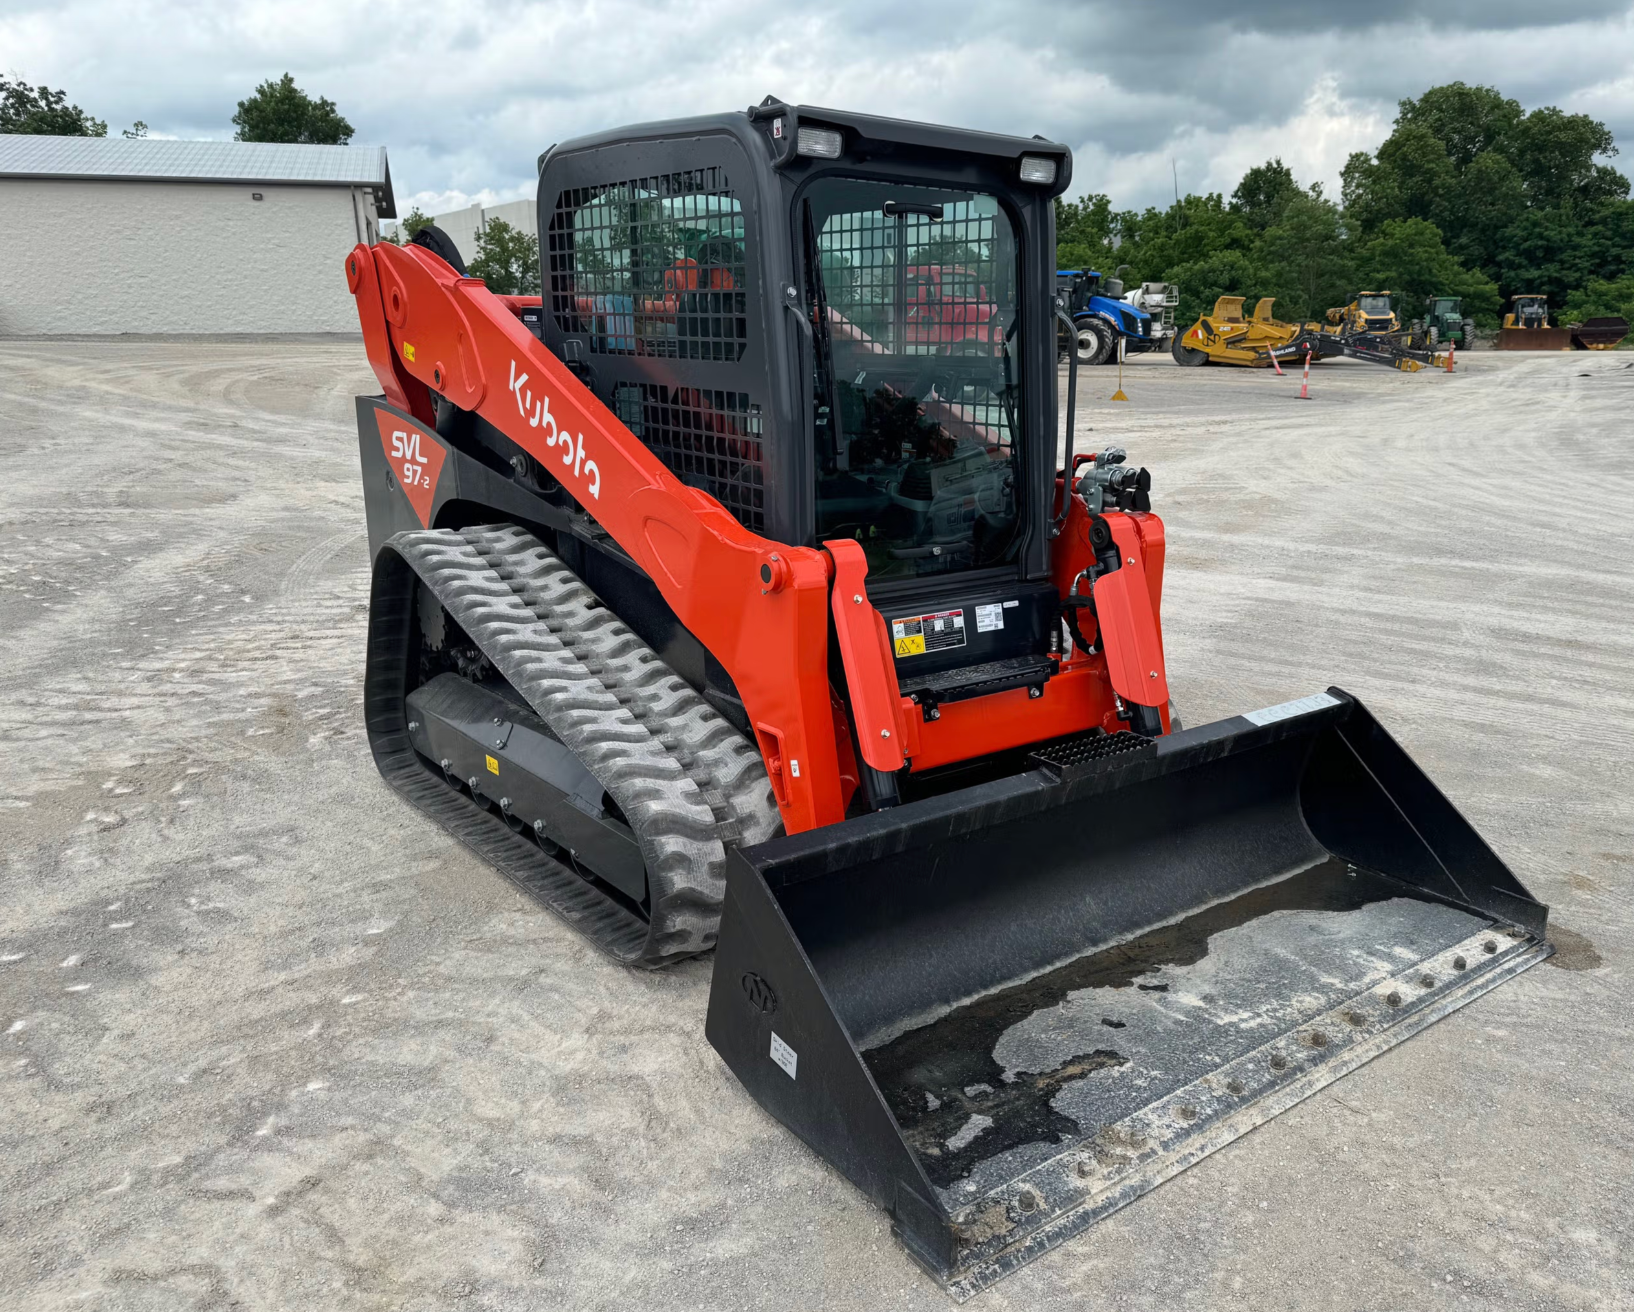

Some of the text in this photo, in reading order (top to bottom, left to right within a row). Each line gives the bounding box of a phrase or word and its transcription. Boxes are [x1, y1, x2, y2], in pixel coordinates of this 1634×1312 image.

[509, 359, 601, 500] Kubota
[391, 430, 428, 464] SVL
[403, 462, 430, 489] 97-2
